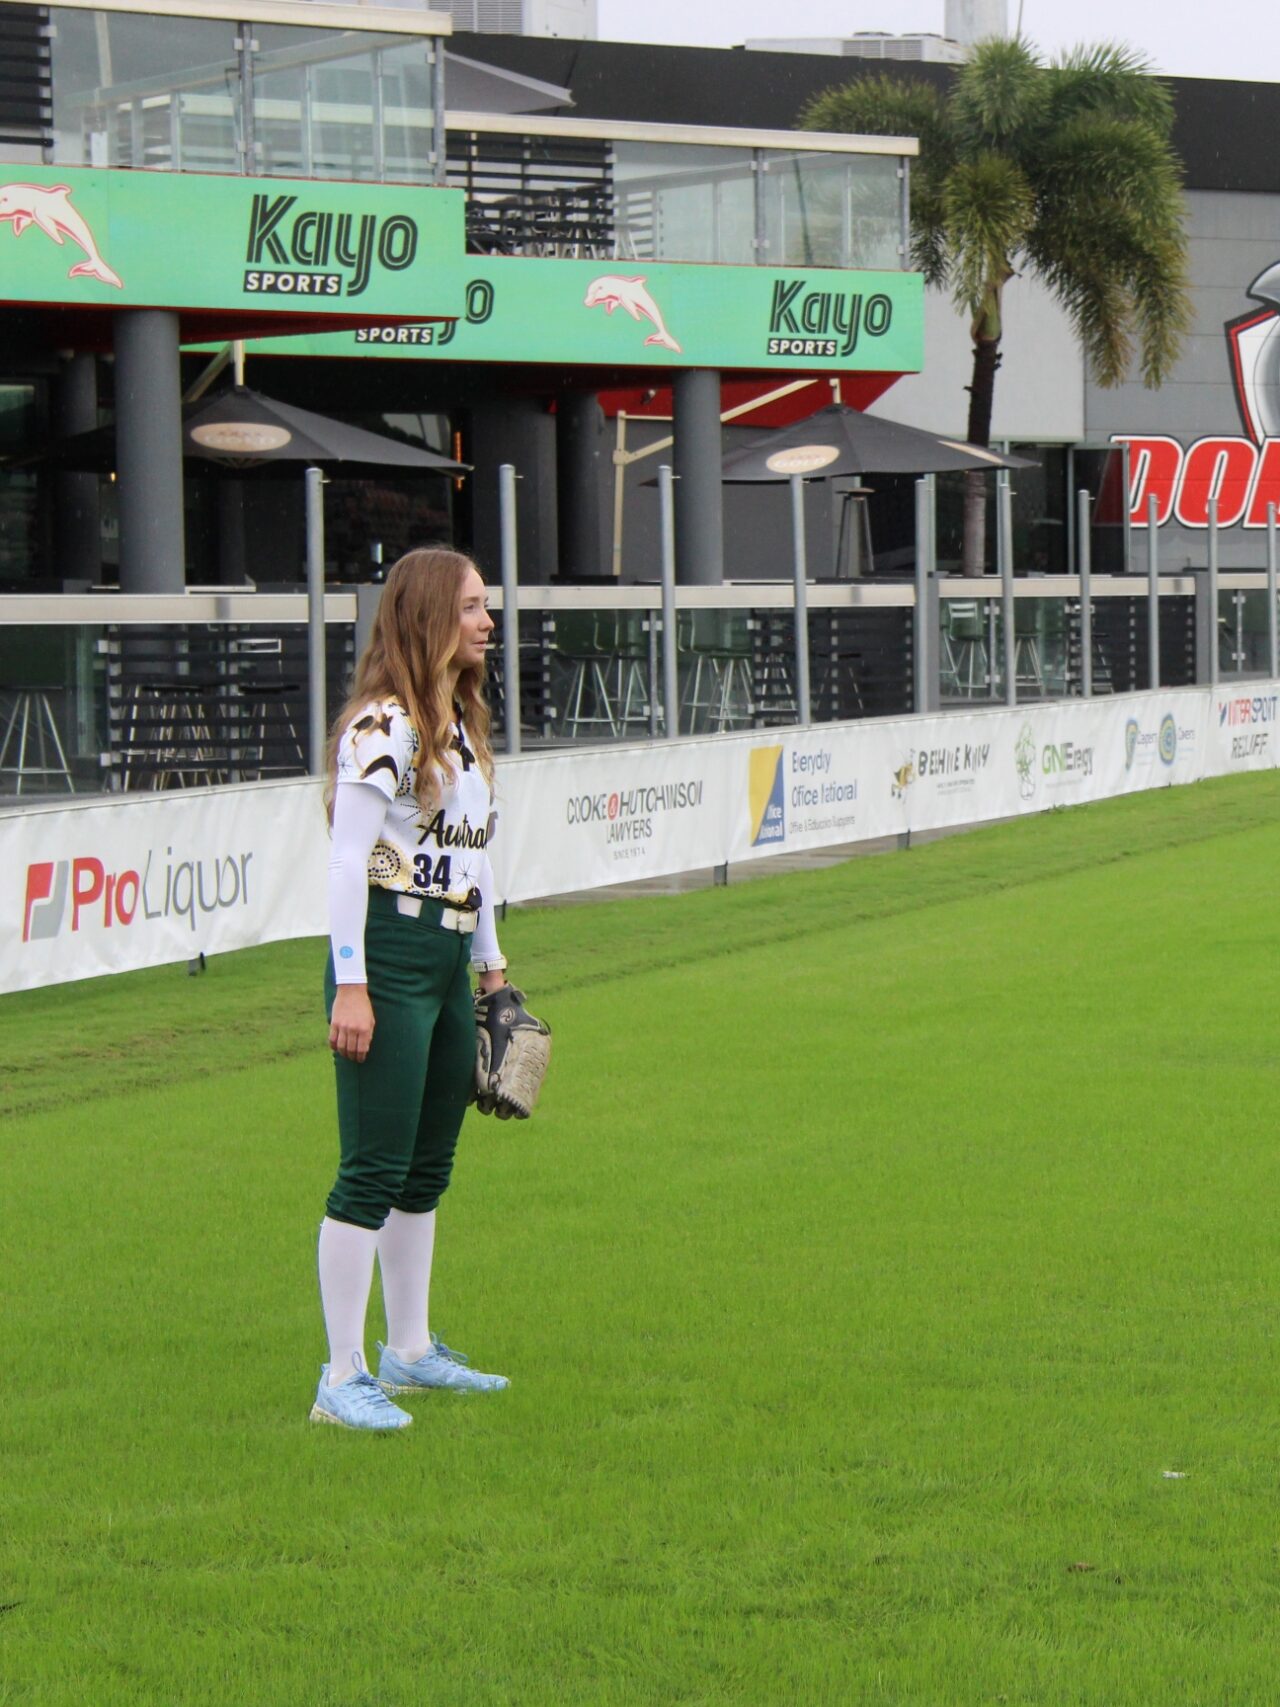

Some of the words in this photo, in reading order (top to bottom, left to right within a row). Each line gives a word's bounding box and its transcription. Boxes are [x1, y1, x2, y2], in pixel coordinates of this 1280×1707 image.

[246, 194, 418, 297] Kayo
[245, 272, 340, 295] SPORTS
[768, 279, 892, 357] Kayo
[357, 326, 432, 344] SPORTS
[768, 338, 837, 356] SPORTS
[567, 793, 607, 825] COOKE
[619, 780, 703, 818] HUTCHINSON
[607, 818, 653, 845] LAWYERS
[412, 852, 452, 892] 34
